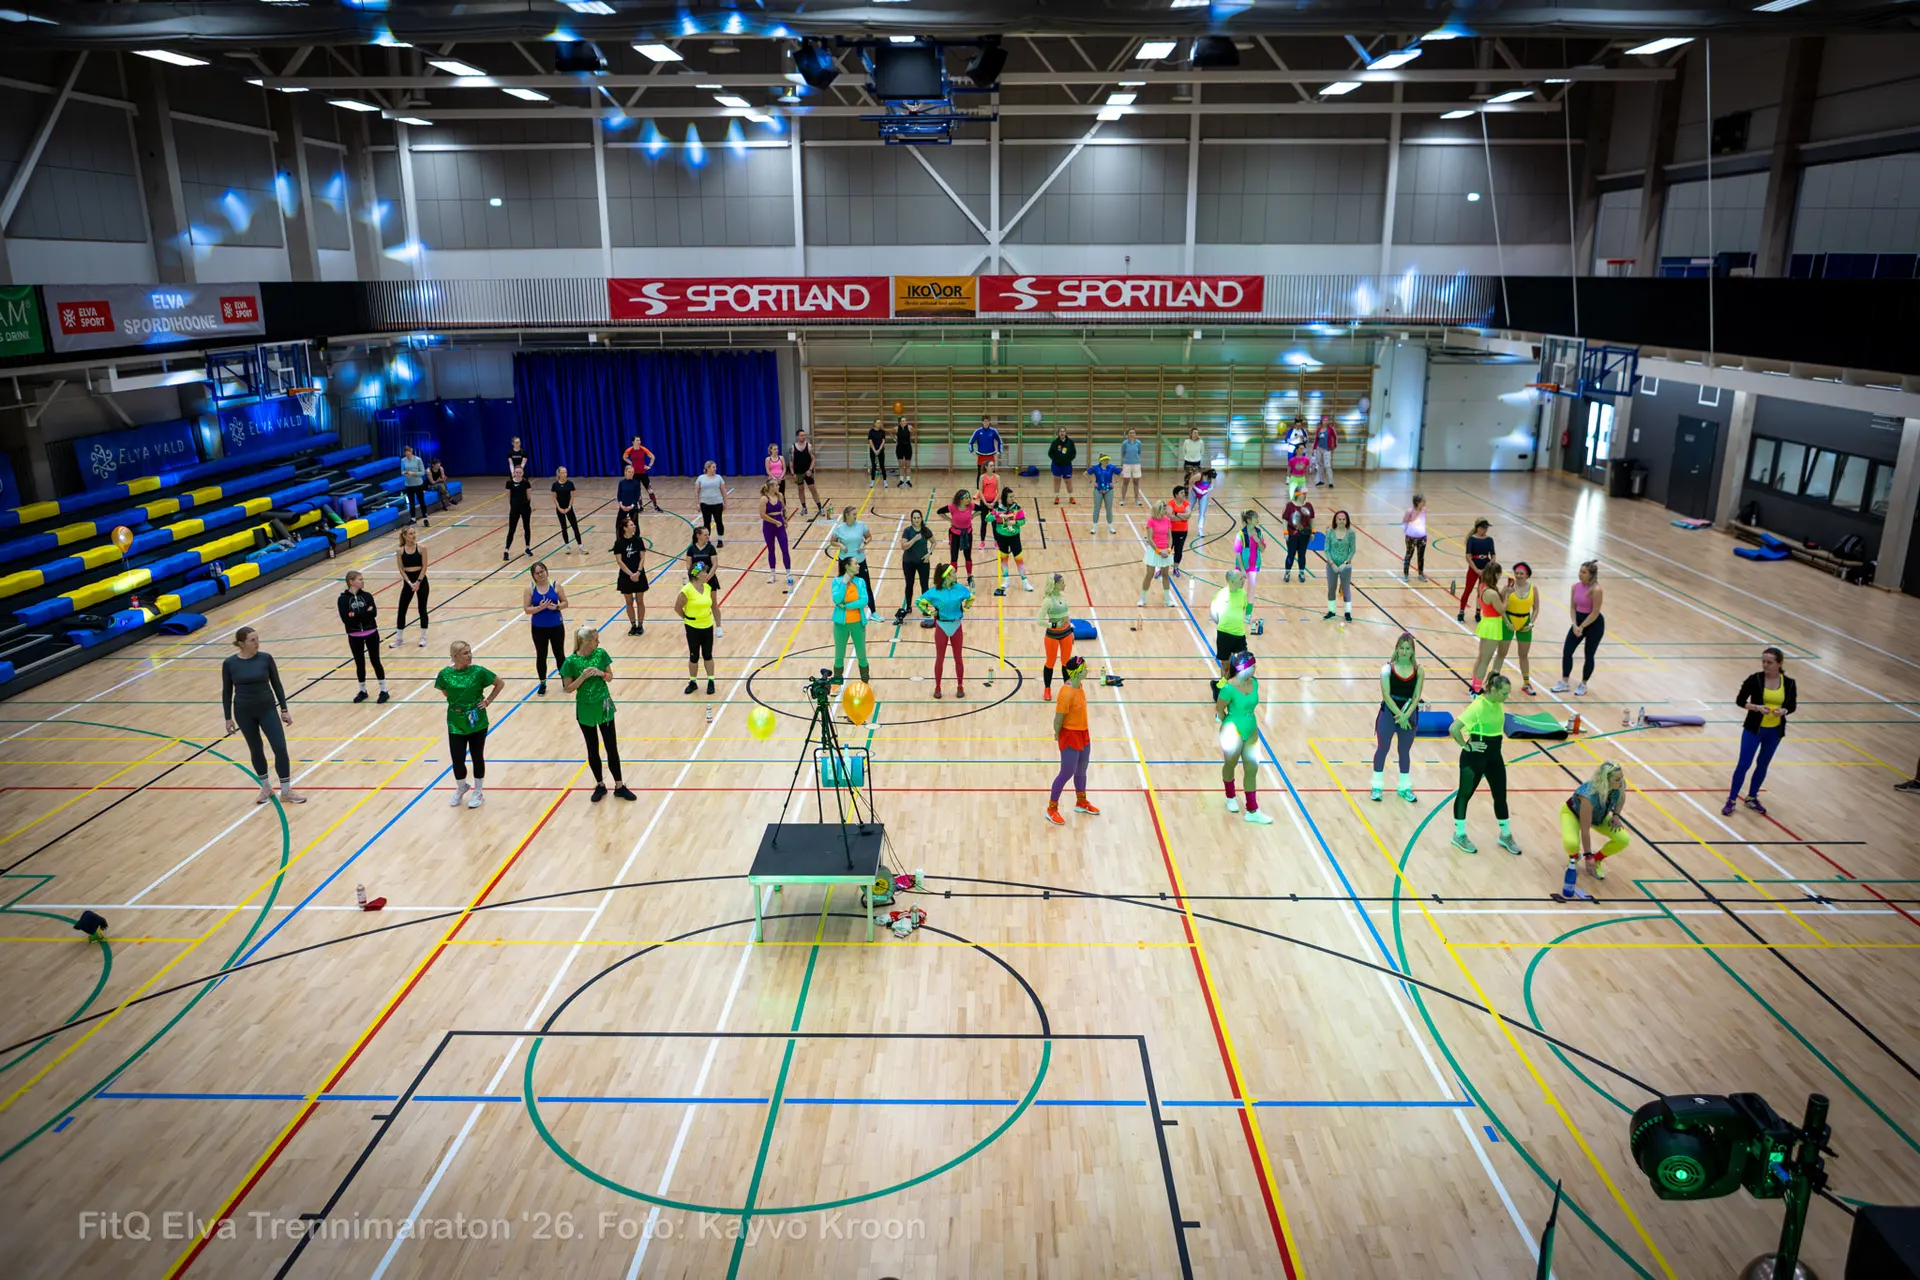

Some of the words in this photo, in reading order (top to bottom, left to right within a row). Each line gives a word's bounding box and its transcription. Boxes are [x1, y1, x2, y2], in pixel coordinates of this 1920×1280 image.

[907, 282, 963, 298] IKODOR
[1057, 279, 1244, 308] SPORTLAND
[151, 294, 186, 310] ELVA
[234, 301, 248, 310] ELVA
[685, 284, 870, 312] SPORTLAND
[78, 307, 98, 317] ELVA
[235, 309, 252, 318] SPORT
[80, 317, 105, 328] SPORT
[123, 314, 218, 335] SPORDIHOONE
[5, 330, 31, 342] DRINK
[276, 415, 302, 429] VALD
[154, 439, 185, 456] VALD
